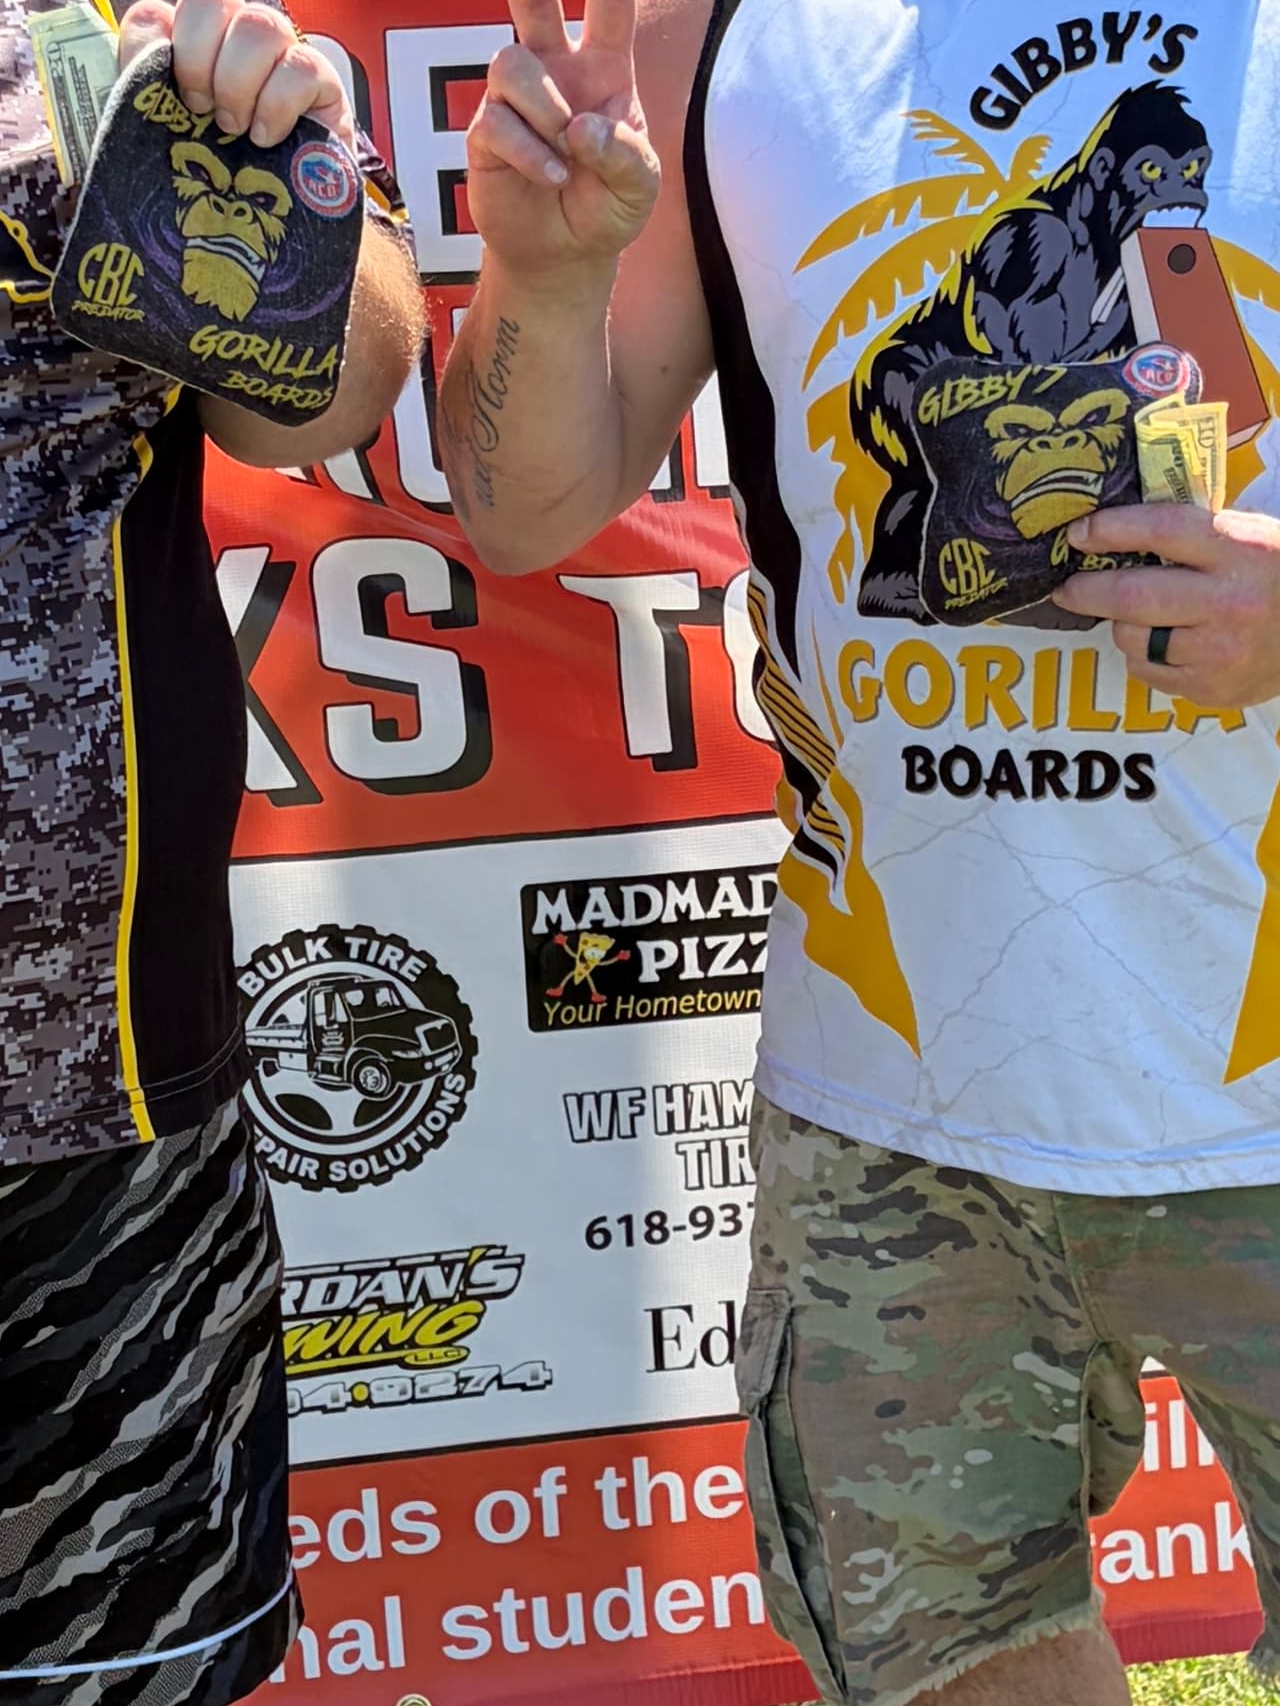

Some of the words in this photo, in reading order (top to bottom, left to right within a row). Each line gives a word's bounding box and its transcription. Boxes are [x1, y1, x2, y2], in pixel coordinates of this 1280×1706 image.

[970, 11, 1200, 131] GIBBY'S
[78, 243, 144, 305] CBC
[72, 300, 145, 323] PREDATOR
[189, 325, 338, 379] GORILLA
[219, 370, 335, 410] BOARDS
[918, 364, 1067, 426] GIBBY'S
[938, 538, 995, 595] CBC
[901, 745, 1158, 802] BOARDS
[236, 936, 333, 998] BULK
[344, 936, 428, 983] TIRE
[544, 1000, 608, 1026] Your
[615, 989, 762, 1021] Hometown
[328, 1072, 467, 1182] SOLUTIONS
[563, 1086, 646, 1143] WF
[675, 1136, 756, 1191] TIR
[585, 1201, 754, 1250] 618-93
[413, 1348, 462, 1362] LLC
[642, 1300, 736, 1374] Ed
[474, 1465, 568, 1545] of
[593, 1455, 745, 1532] the
[441, 1565, 767, 1662] studen
[1090, 1500, 1254, 1585] ank
